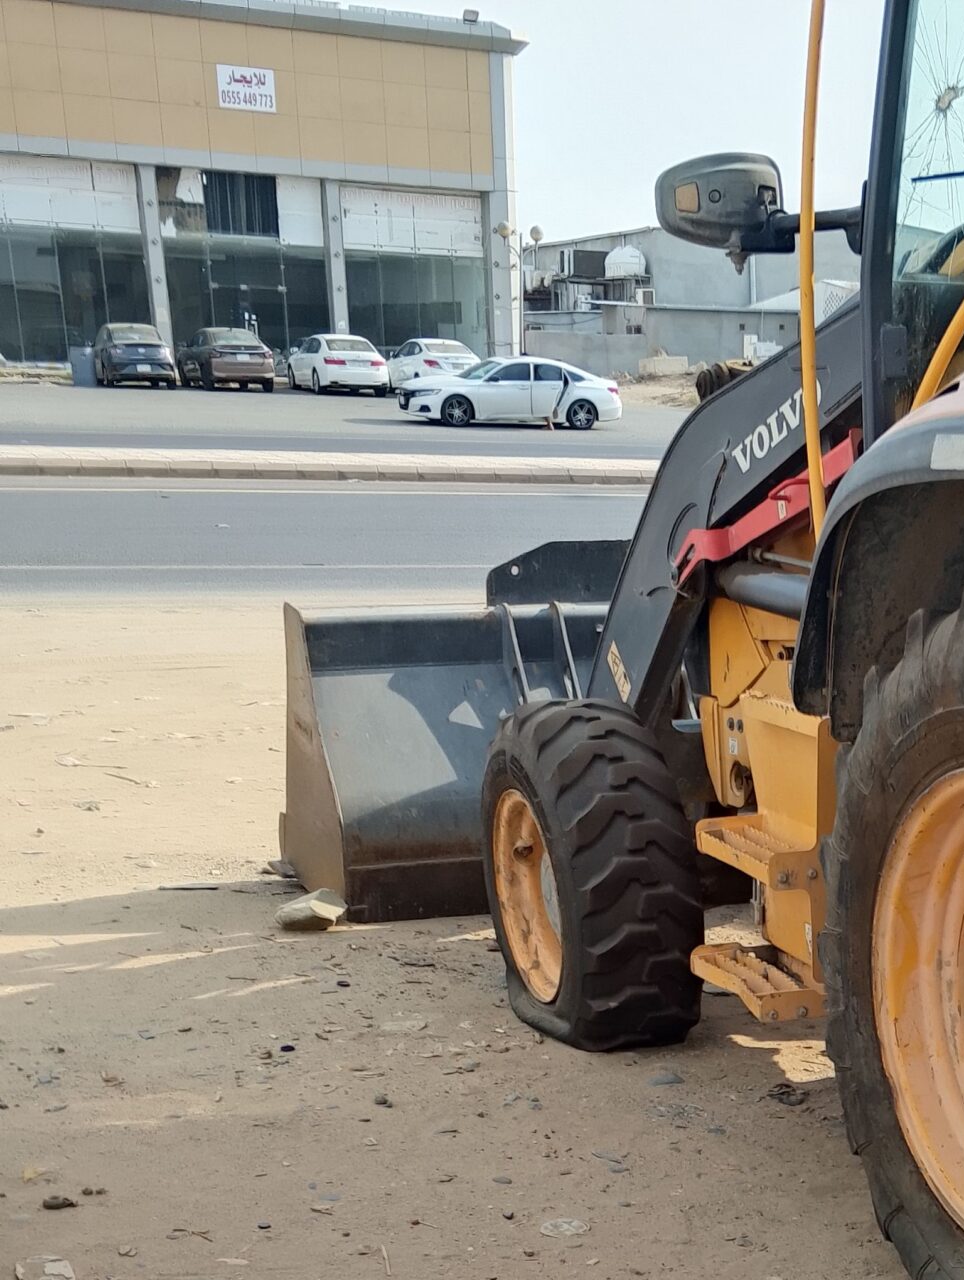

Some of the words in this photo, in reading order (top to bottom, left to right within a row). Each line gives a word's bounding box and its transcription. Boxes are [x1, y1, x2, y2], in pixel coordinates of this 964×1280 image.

[221, 89, 241, 105] 0555
[242, 91, 257, 107] 449
[258, 93, 273, 108] 773
